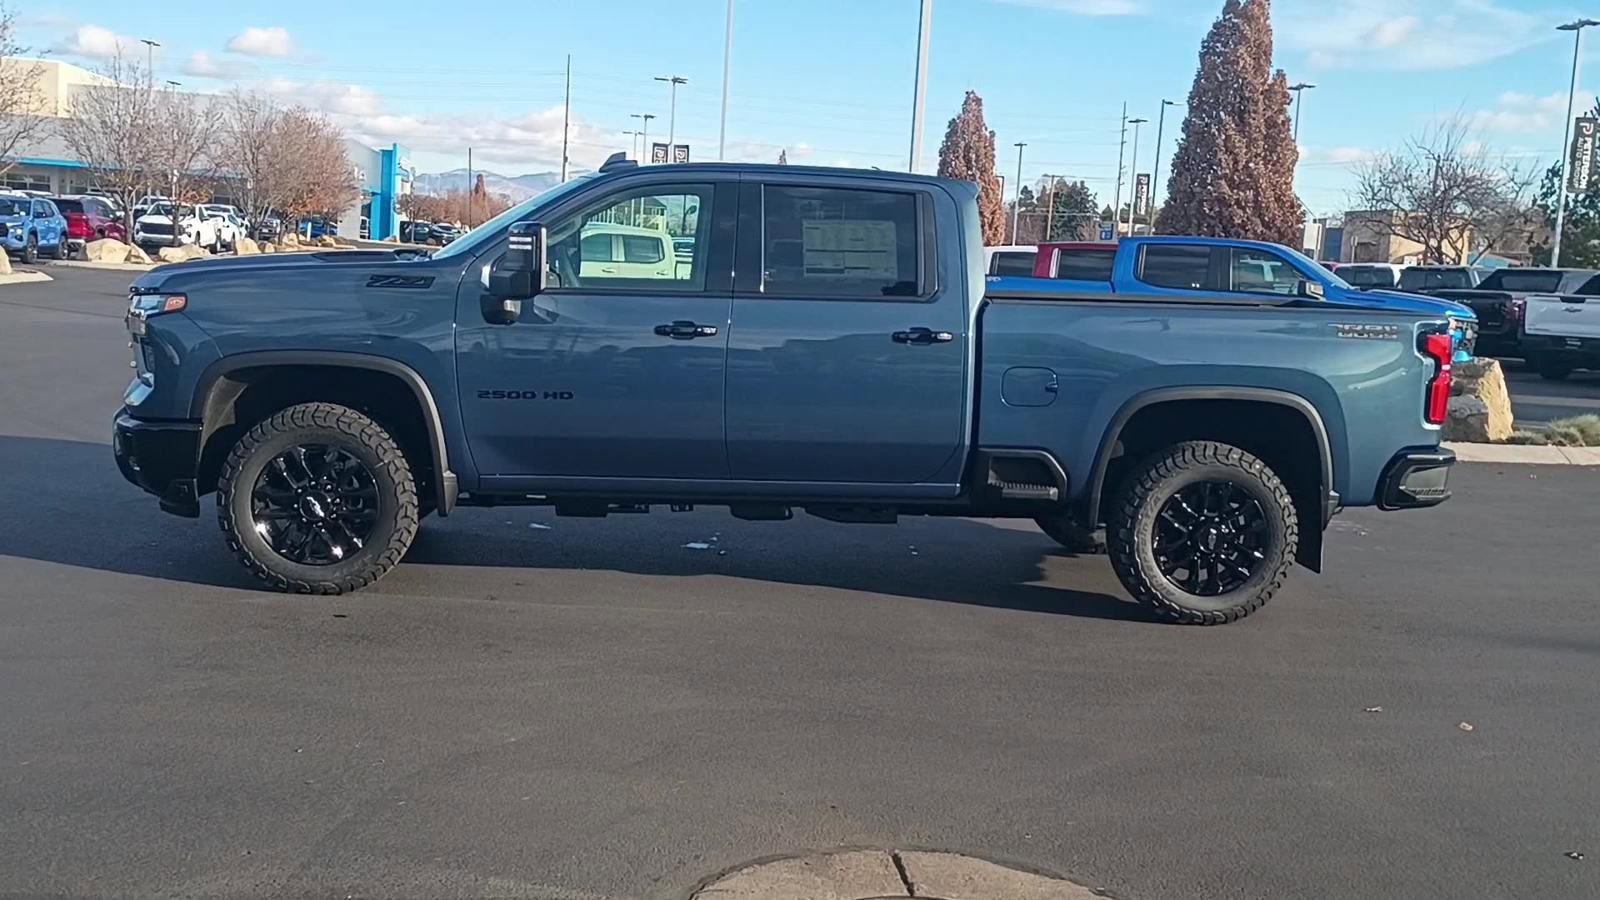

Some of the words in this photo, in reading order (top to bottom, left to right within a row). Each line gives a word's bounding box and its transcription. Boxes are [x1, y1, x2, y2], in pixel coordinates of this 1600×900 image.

[1576, 136, 1584, 158] AUTO
[1579, 136, 1593, 189] PETERSON
[477, 390, 537, 400] 2500
[543, 391, 574, 400] HD
